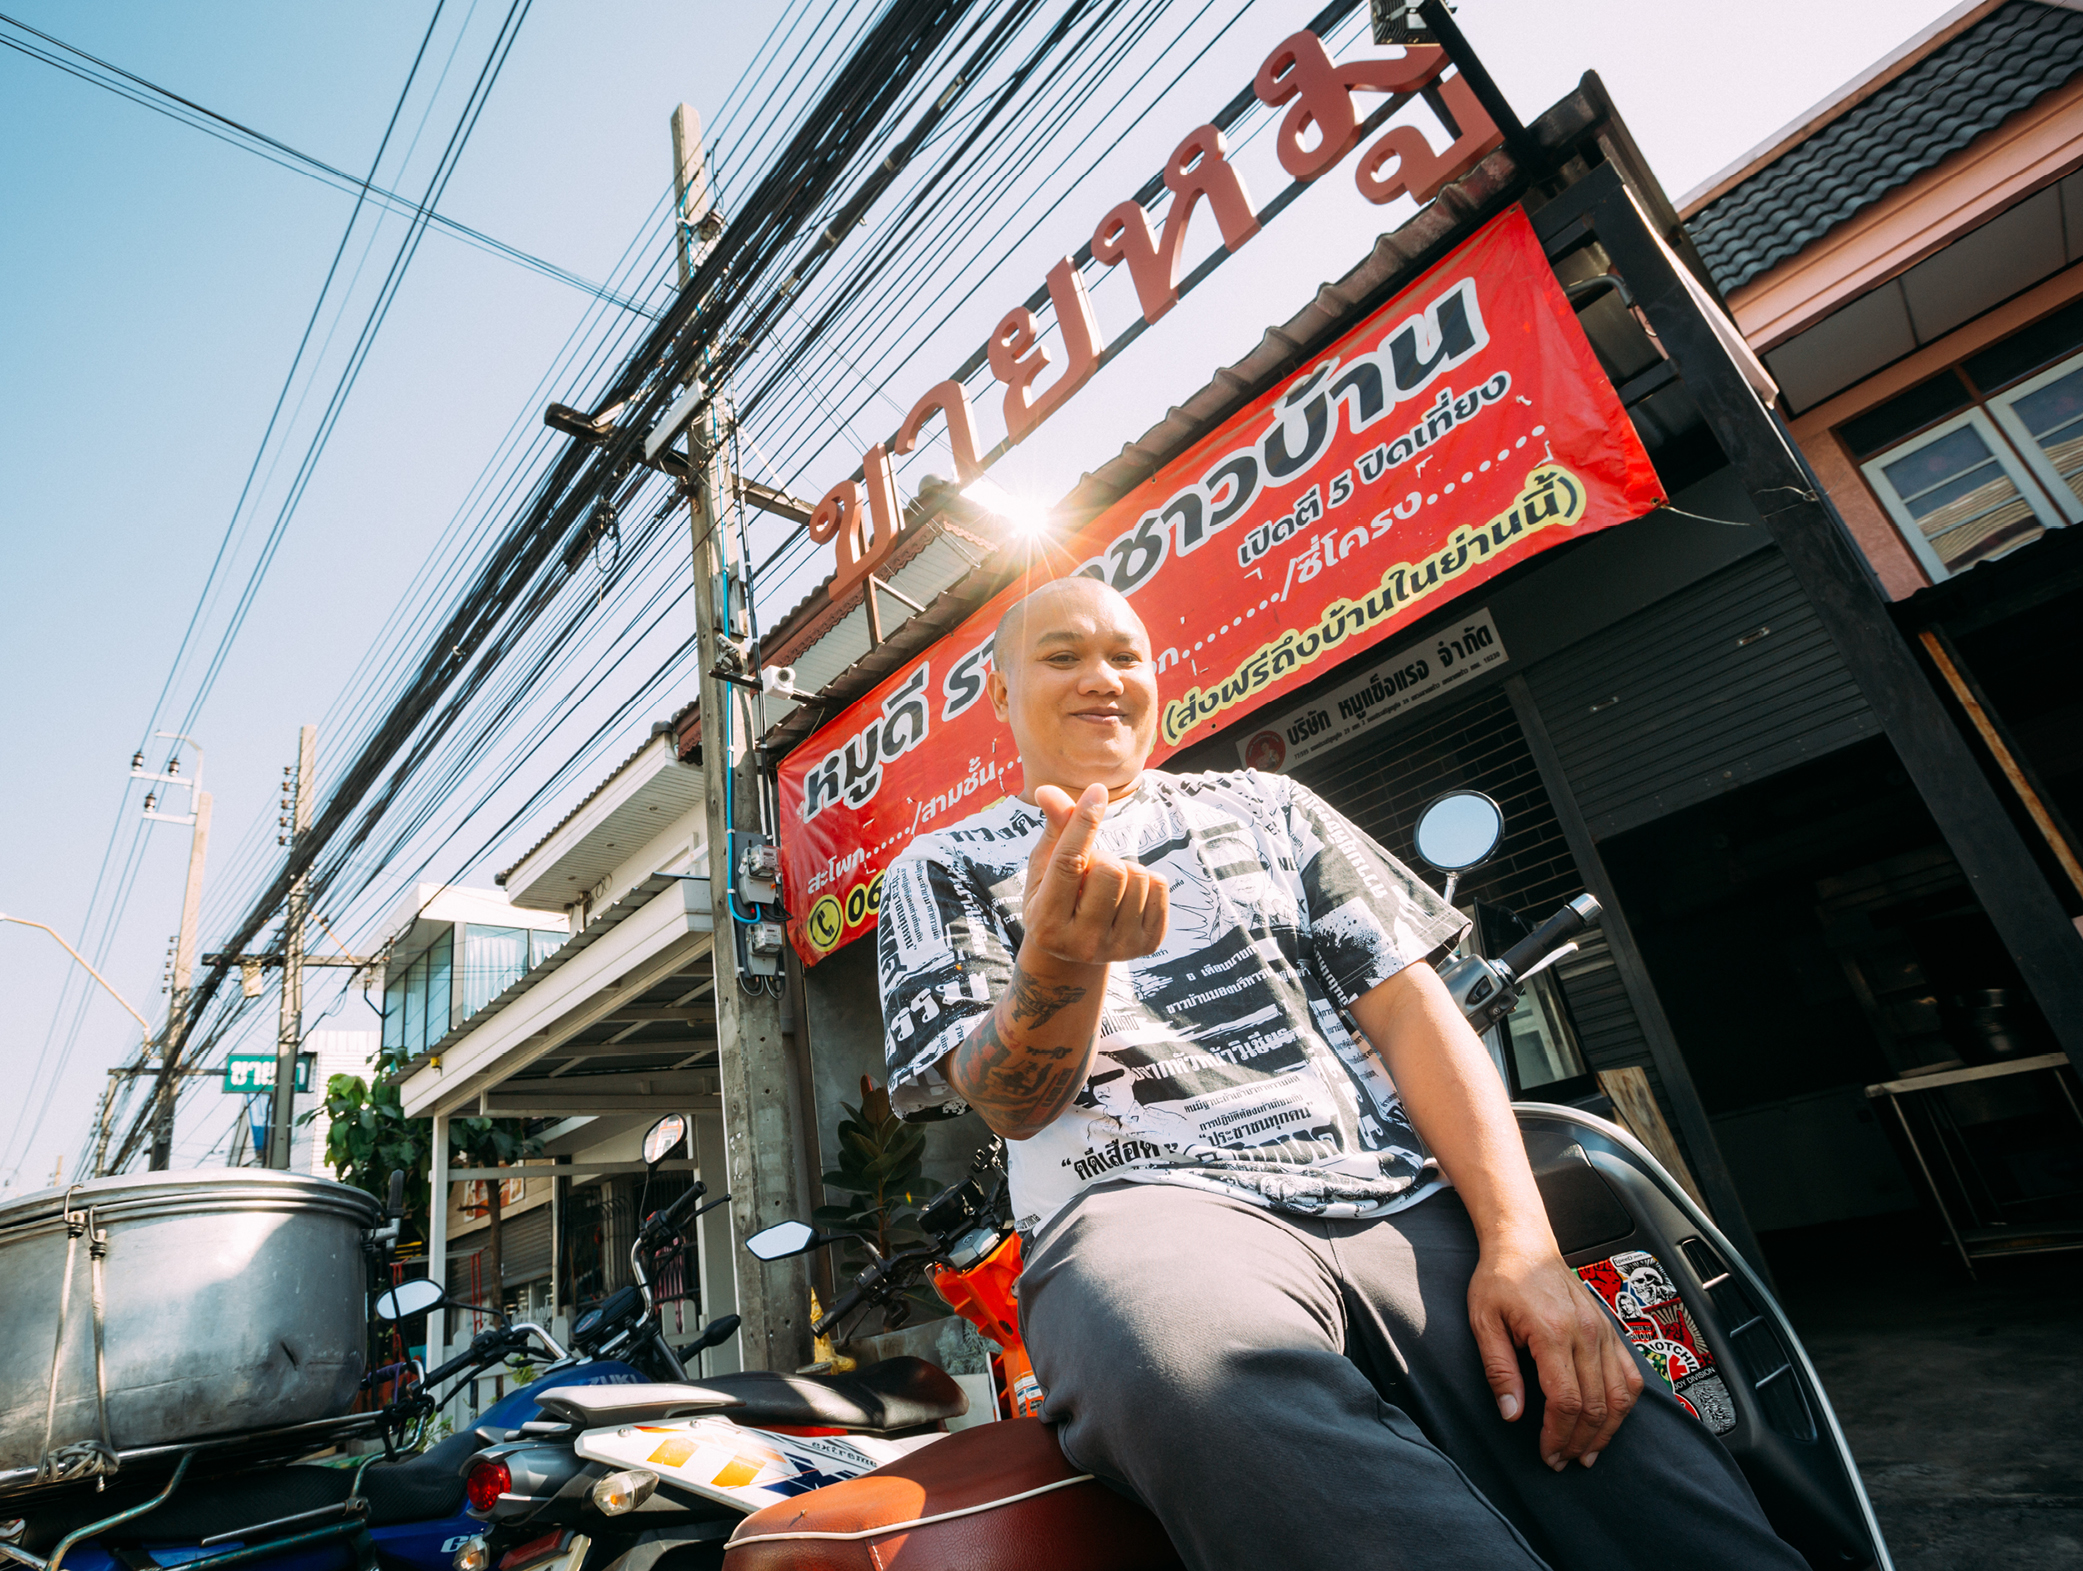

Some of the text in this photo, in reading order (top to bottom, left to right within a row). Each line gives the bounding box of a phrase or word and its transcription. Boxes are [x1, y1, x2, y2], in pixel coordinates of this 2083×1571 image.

[1327, 474, 1355, 511] 5
[1359, 371, 1511, 482] ปิดเที่ยง
[1164, 465, 1582, 742] (ส่งฟรีถึงบ้านในย่านนี้)
[801, 663, 929, 822] หมูดี
[1286, 709, 1332, 746] บริษัท
[1338, 659, 1430, 720] หมูแข็งแรง
[1437, 624, 1493, 668] จำกัด
[1686, 1366, 1716, 1384] DIVISION
[811, 1441, 877, 1468] extreme
